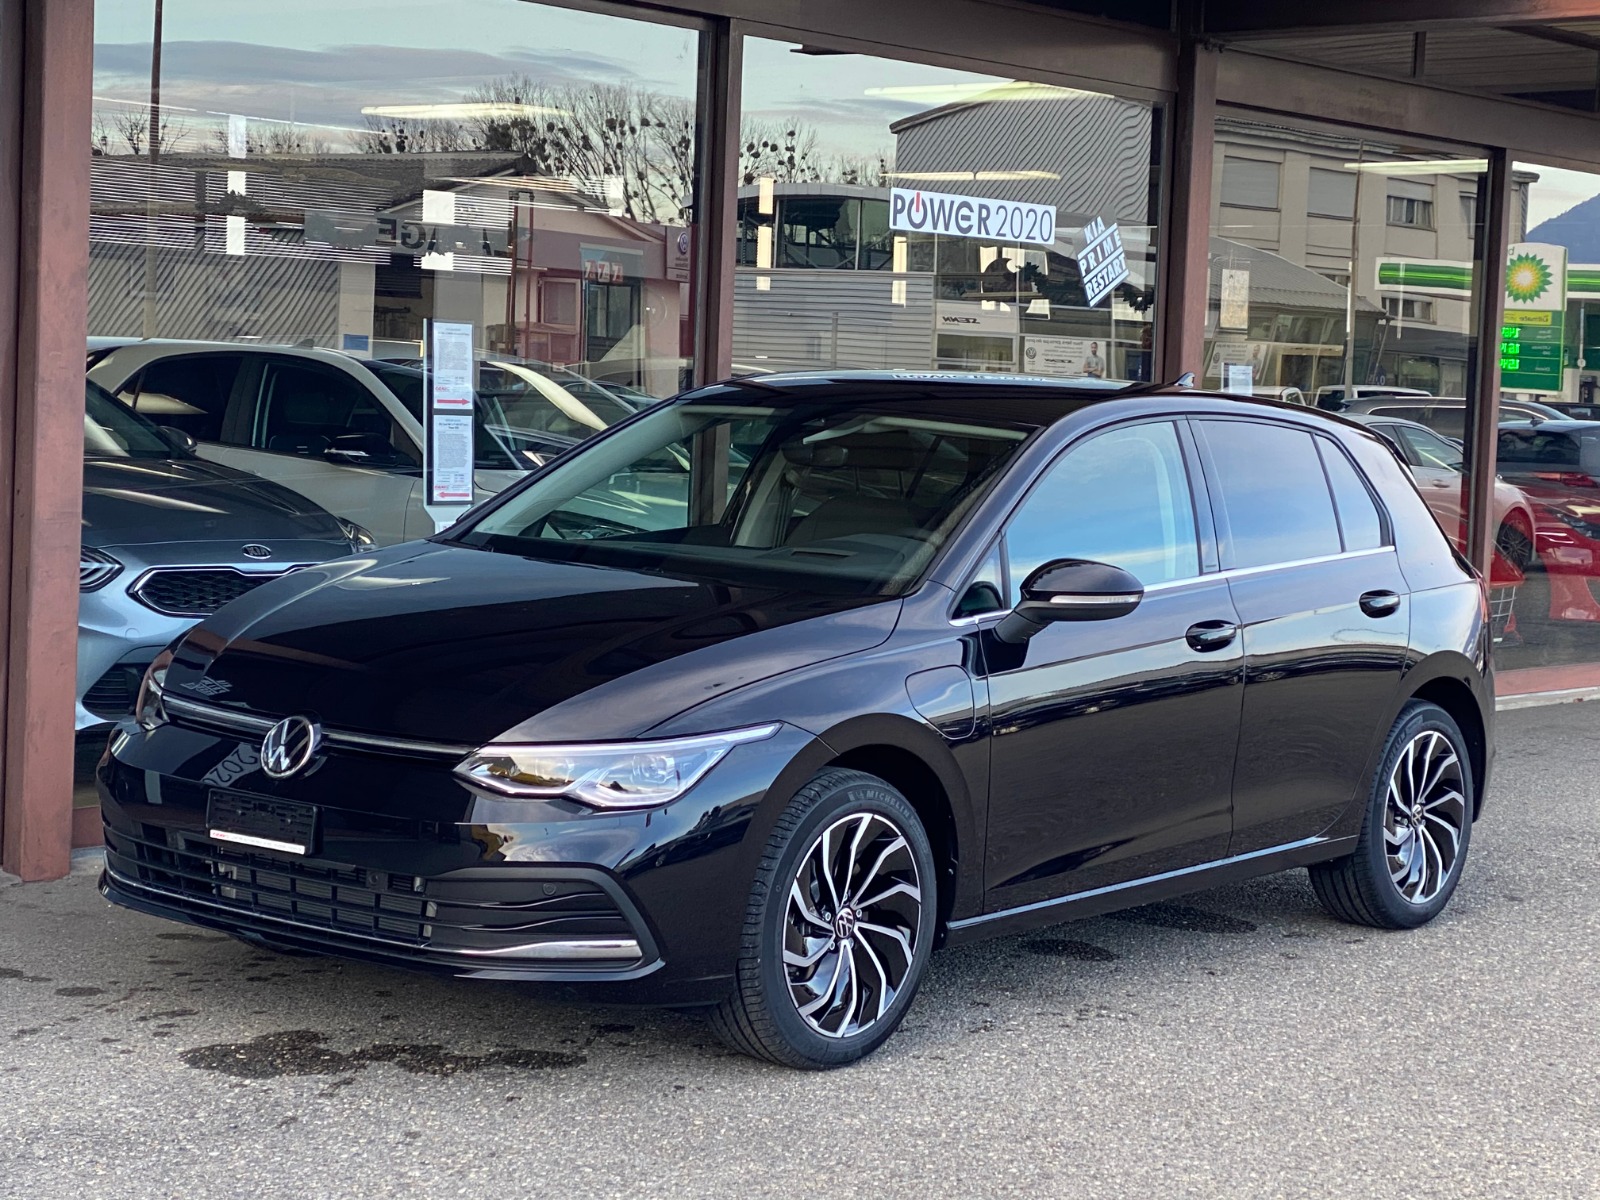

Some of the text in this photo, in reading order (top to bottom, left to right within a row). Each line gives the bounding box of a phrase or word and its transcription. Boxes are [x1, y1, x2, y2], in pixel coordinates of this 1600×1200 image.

[1084, 215, 1106, 244] KIA
[1079, 229, 1122, 277] PRIME
[1085, 252, 1127, 301] RESTART
[866, 790, 910, 817] MICHELIN
